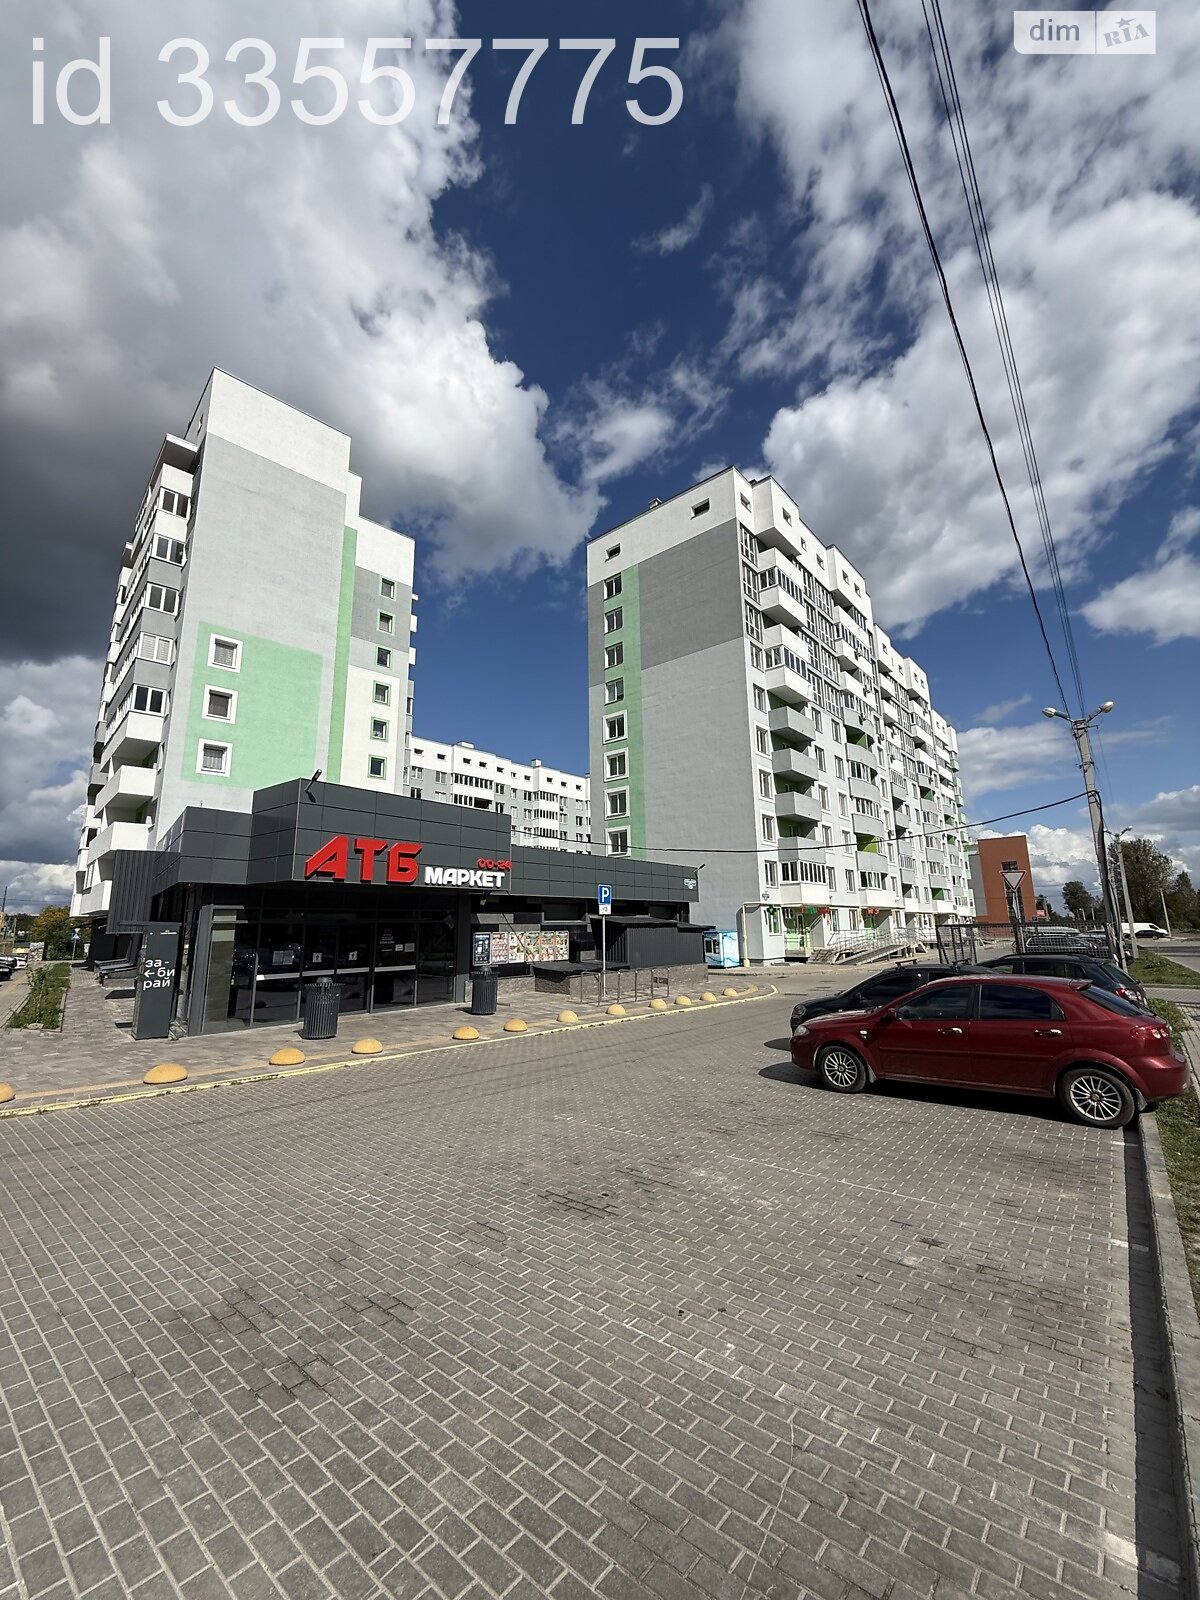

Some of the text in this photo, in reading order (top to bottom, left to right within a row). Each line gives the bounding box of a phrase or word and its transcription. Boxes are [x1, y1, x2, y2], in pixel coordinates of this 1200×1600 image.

[304, 835, 423, 885] АТБ
[425, 866, 505, 888] МАРКЕТ
[601, 886, 610, 903] P
[157, 967, 175, 978] би
[143, 976, 170, 991] рай
